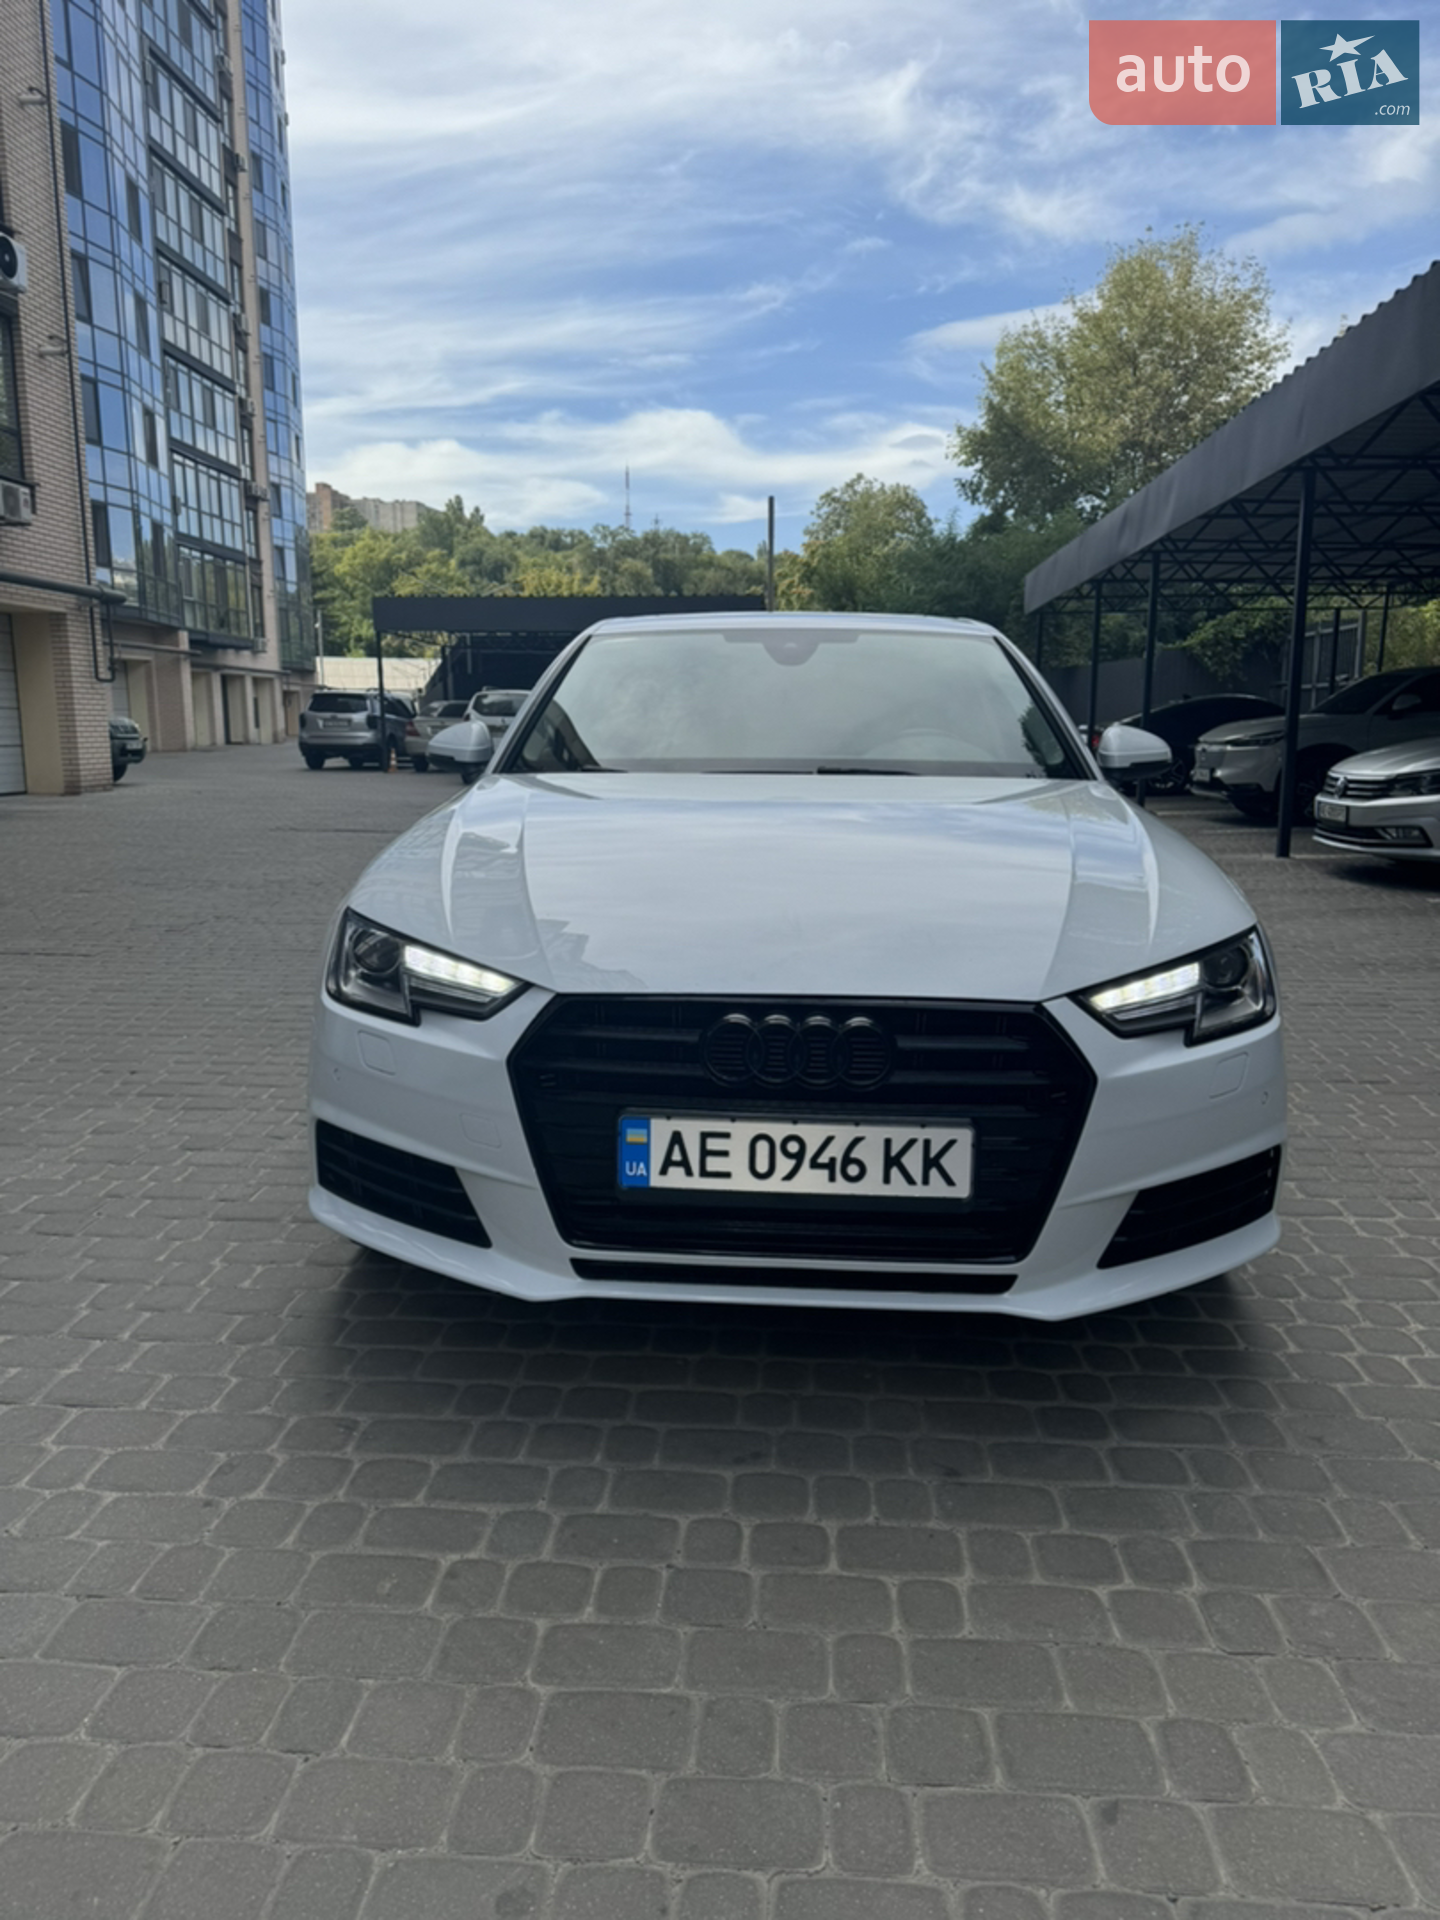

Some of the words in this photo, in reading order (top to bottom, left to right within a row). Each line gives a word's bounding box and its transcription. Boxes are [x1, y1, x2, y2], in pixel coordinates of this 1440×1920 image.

[625, 1161, 647, 1176] UA
[658, 1130, 732, 1178] AE
[748, 1133, 867, 1183] 0946
[882, 1137, 958, 1187] KK
